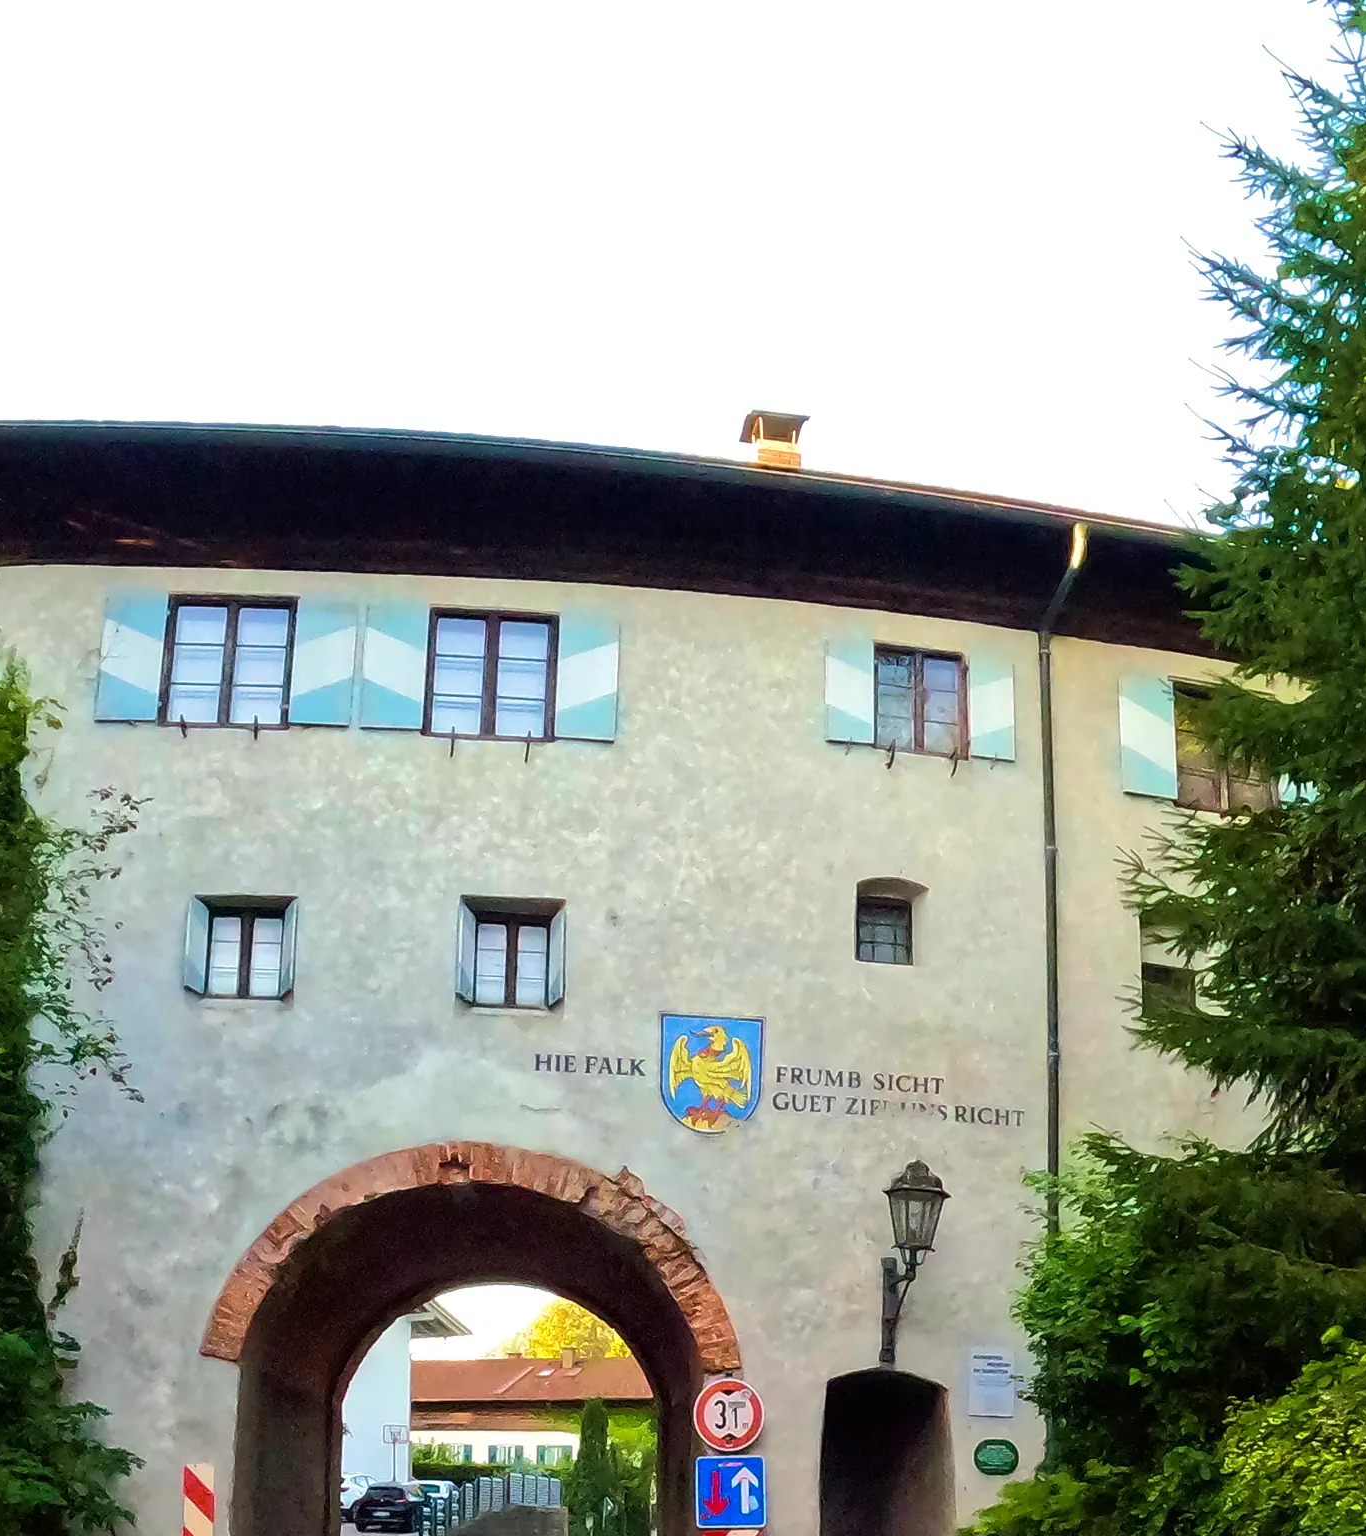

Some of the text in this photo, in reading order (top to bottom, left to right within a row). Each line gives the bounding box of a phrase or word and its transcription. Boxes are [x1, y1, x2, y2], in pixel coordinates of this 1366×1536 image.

[534, 1053, 647, 1077] HIE FALK
[775, 1066, 945, 1095] FRUMB SICHT
[772, 1092, 837, 1114] GUET
[954, 1105, 1025, 1127] RICHT
